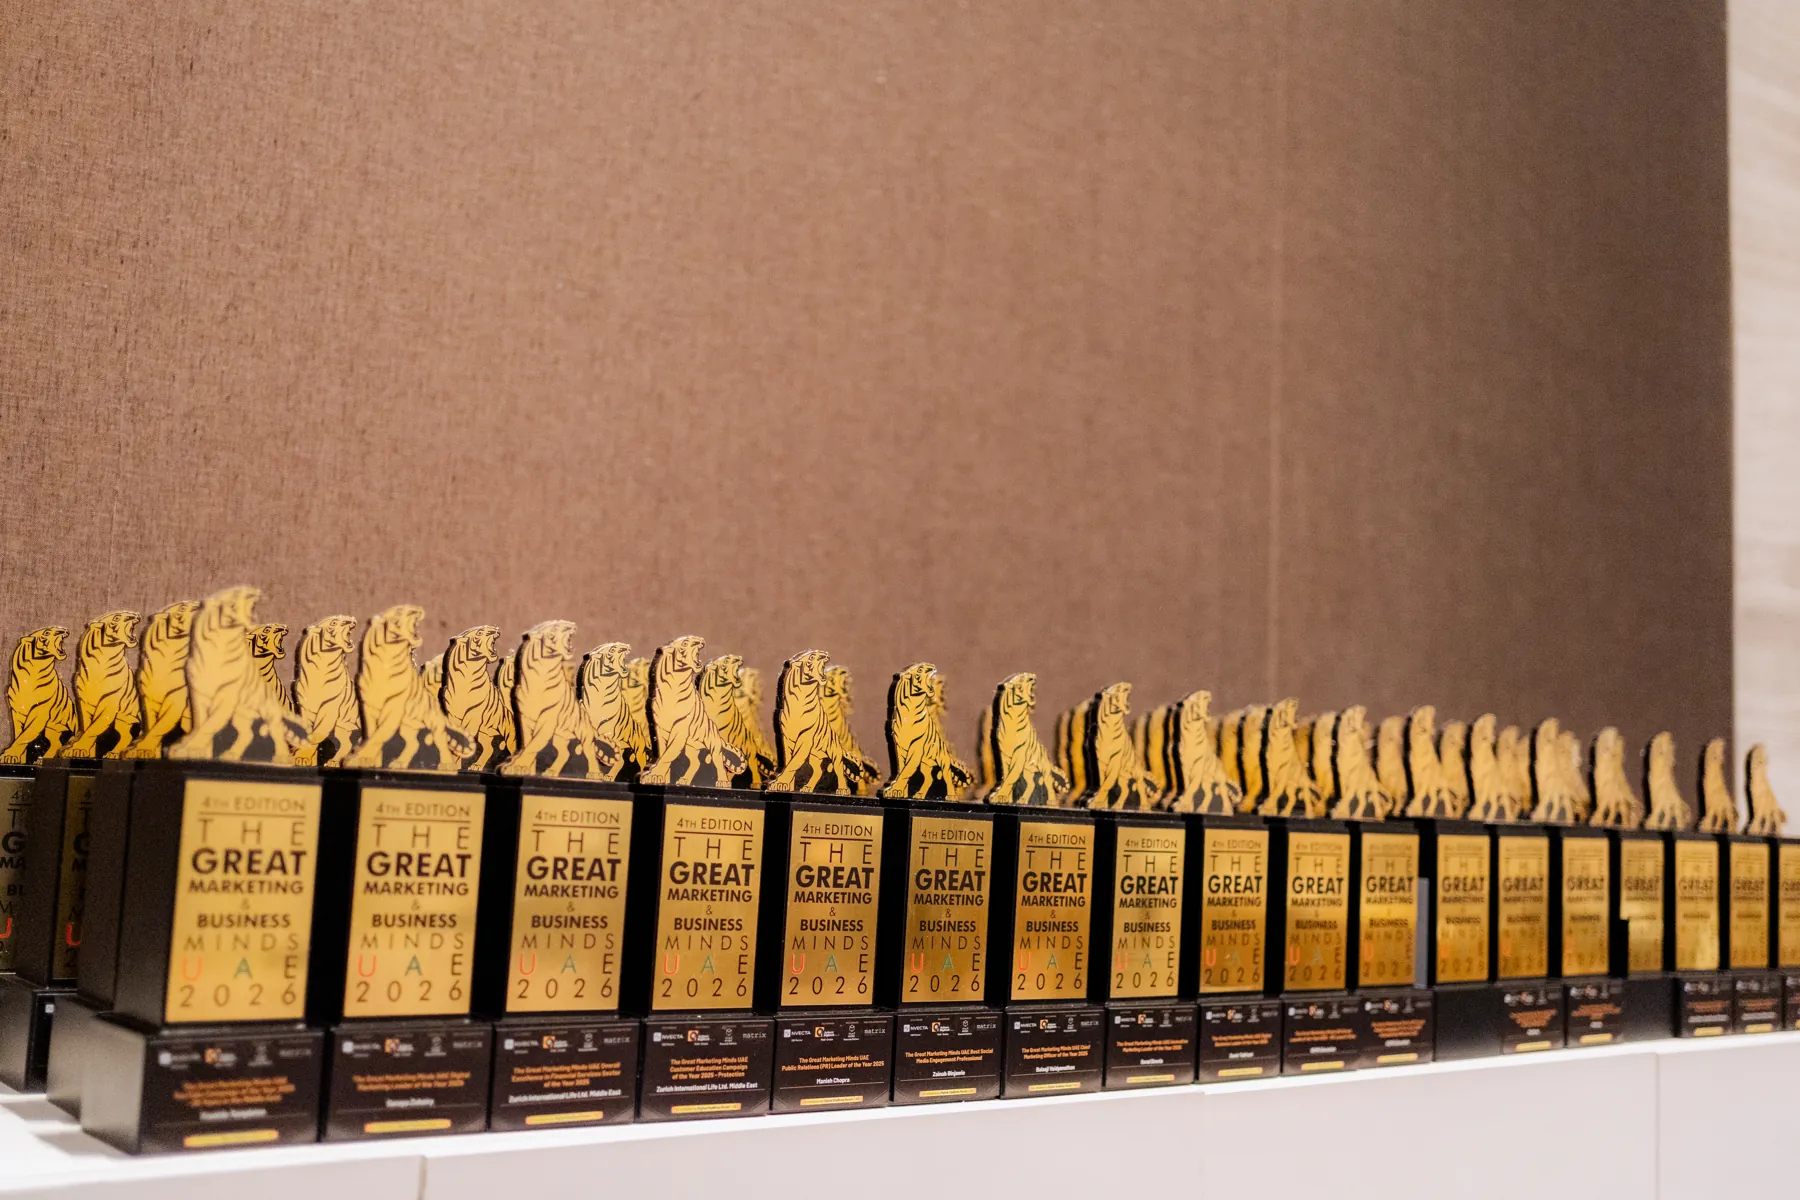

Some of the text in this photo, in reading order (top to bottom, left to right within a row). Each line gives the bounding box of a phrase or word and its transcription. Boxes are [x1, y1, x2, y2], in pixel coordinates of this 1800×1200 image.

[233, 795, 306, 811] EDITION
[404, 802, 470, 817] EDITION
[560, 808, 620, 823] EDITION
[700, 817, 753, 831] EDITION
[194, 818, 305, 845] THE
[368, 824, 470, 849] THE
[824, 823, 872, 836] EDITION
[940, 828, 984, 841] EDITION
[1046, 833, 1086, 844] EDITION
[528, 829, 620, 854] THE
[671, 836, 753, 860] THE
[1141, 837, 1177, 848] EDITION
[1227, 838, 1262, 849] EDITION
[188, 846, 308, 876] GREAT
[798, 841, 872, 864] THE
[917, 845, 984, 867] THE
[1024, 849, 1086, 870] THE
[363, 851, 473, 878] GREAT
[524, 854, 622, 881] GREAT
[1122, 853, 1177, 872] THE
[1209, 854, 1262, 872] THE
[667, 860, 755, 887] GREAT
[794, 864, 874, 889] GREAT
[914, 867, 985, 890] GREAT
[1022, 870, 1088, 893] GREAT
[186, 878, 305, 894] MARKETING
[362, 881, 470, 896] MARKETING
[522, 883, 619, 898] MARKETING
[1119, 873, 1179, 894] GREAT
[1207, 874, 1264, 893] GREAT
[1291, 876, 1345, 895] GREAT
[1364, 875, 1415, 894] GREAT
[666, 888, 752, 903] MARKETING
[793, 890, 872, 904] MARKETING
[913, 892, 984, 905] MARKETING
[1021, 894, 1086, 906] MARKETING
[1118, 896, 1178, 907] MARKETING
[1207, 896, 1262, 906] MARKETING
[195, 913, 292, 928] BUSINESS
[370, 914, 458, 928] BUSINESS
[530, 915, 608, 928] BUSINESS
[672, 918, 743, 931] BUSINESS
[799, 918, 864, 931] BUSINESS
[918, 919, 976, 931] BUSINESS
[1026, 920, 1079, 931] BUSINESS
[1123, 921, 1171, 932] BUSINESS
[1211, 919, 1257, 930] BUSINESS
[183, 932, 299, 952] MINDS
[359, 933, 465, 951] MINDS
[520, 932, 615, 949] MINDS
[664, 935, 748, 951] MINDS
[791, 934, 869, 950] MINDS
[911, 934, 981, 948] MINDS
[1019, 934, 1084, 948] MINDS
[1117, 934, 1175, 948] MINDS
[1206, 932, 1261, 946] MINDS
[518, 952, 614, 976] UAE
[662, 954, 748, 976] UAE
[790, 953, 868, 974] UAE
[910, 951, 980, 972] UAE
[1018, 951, 1083, 970] UAE
[1117, 950, 1175, 969] UAE
[1206, 947, 1260, 966] UAE
[180, 954, 298, 982] UAE
[357, 953, 464, 979] UAE
[1204, 966, 1261, 984] 2026
[660, 978, 747, 998] 2026
[788, 975, 868, 995] 2026
[909, 973, 980, 992] 2026
[1017, 972, 1083, 990] 2026
[1115, 970, 1175, 988] 2026
[177, 982, 298, 1008] 2026
[354, 979, 464, 1004] 2026
[516, 977, 614, 1000] 2026
[674, 1084, 707, 1092] International
